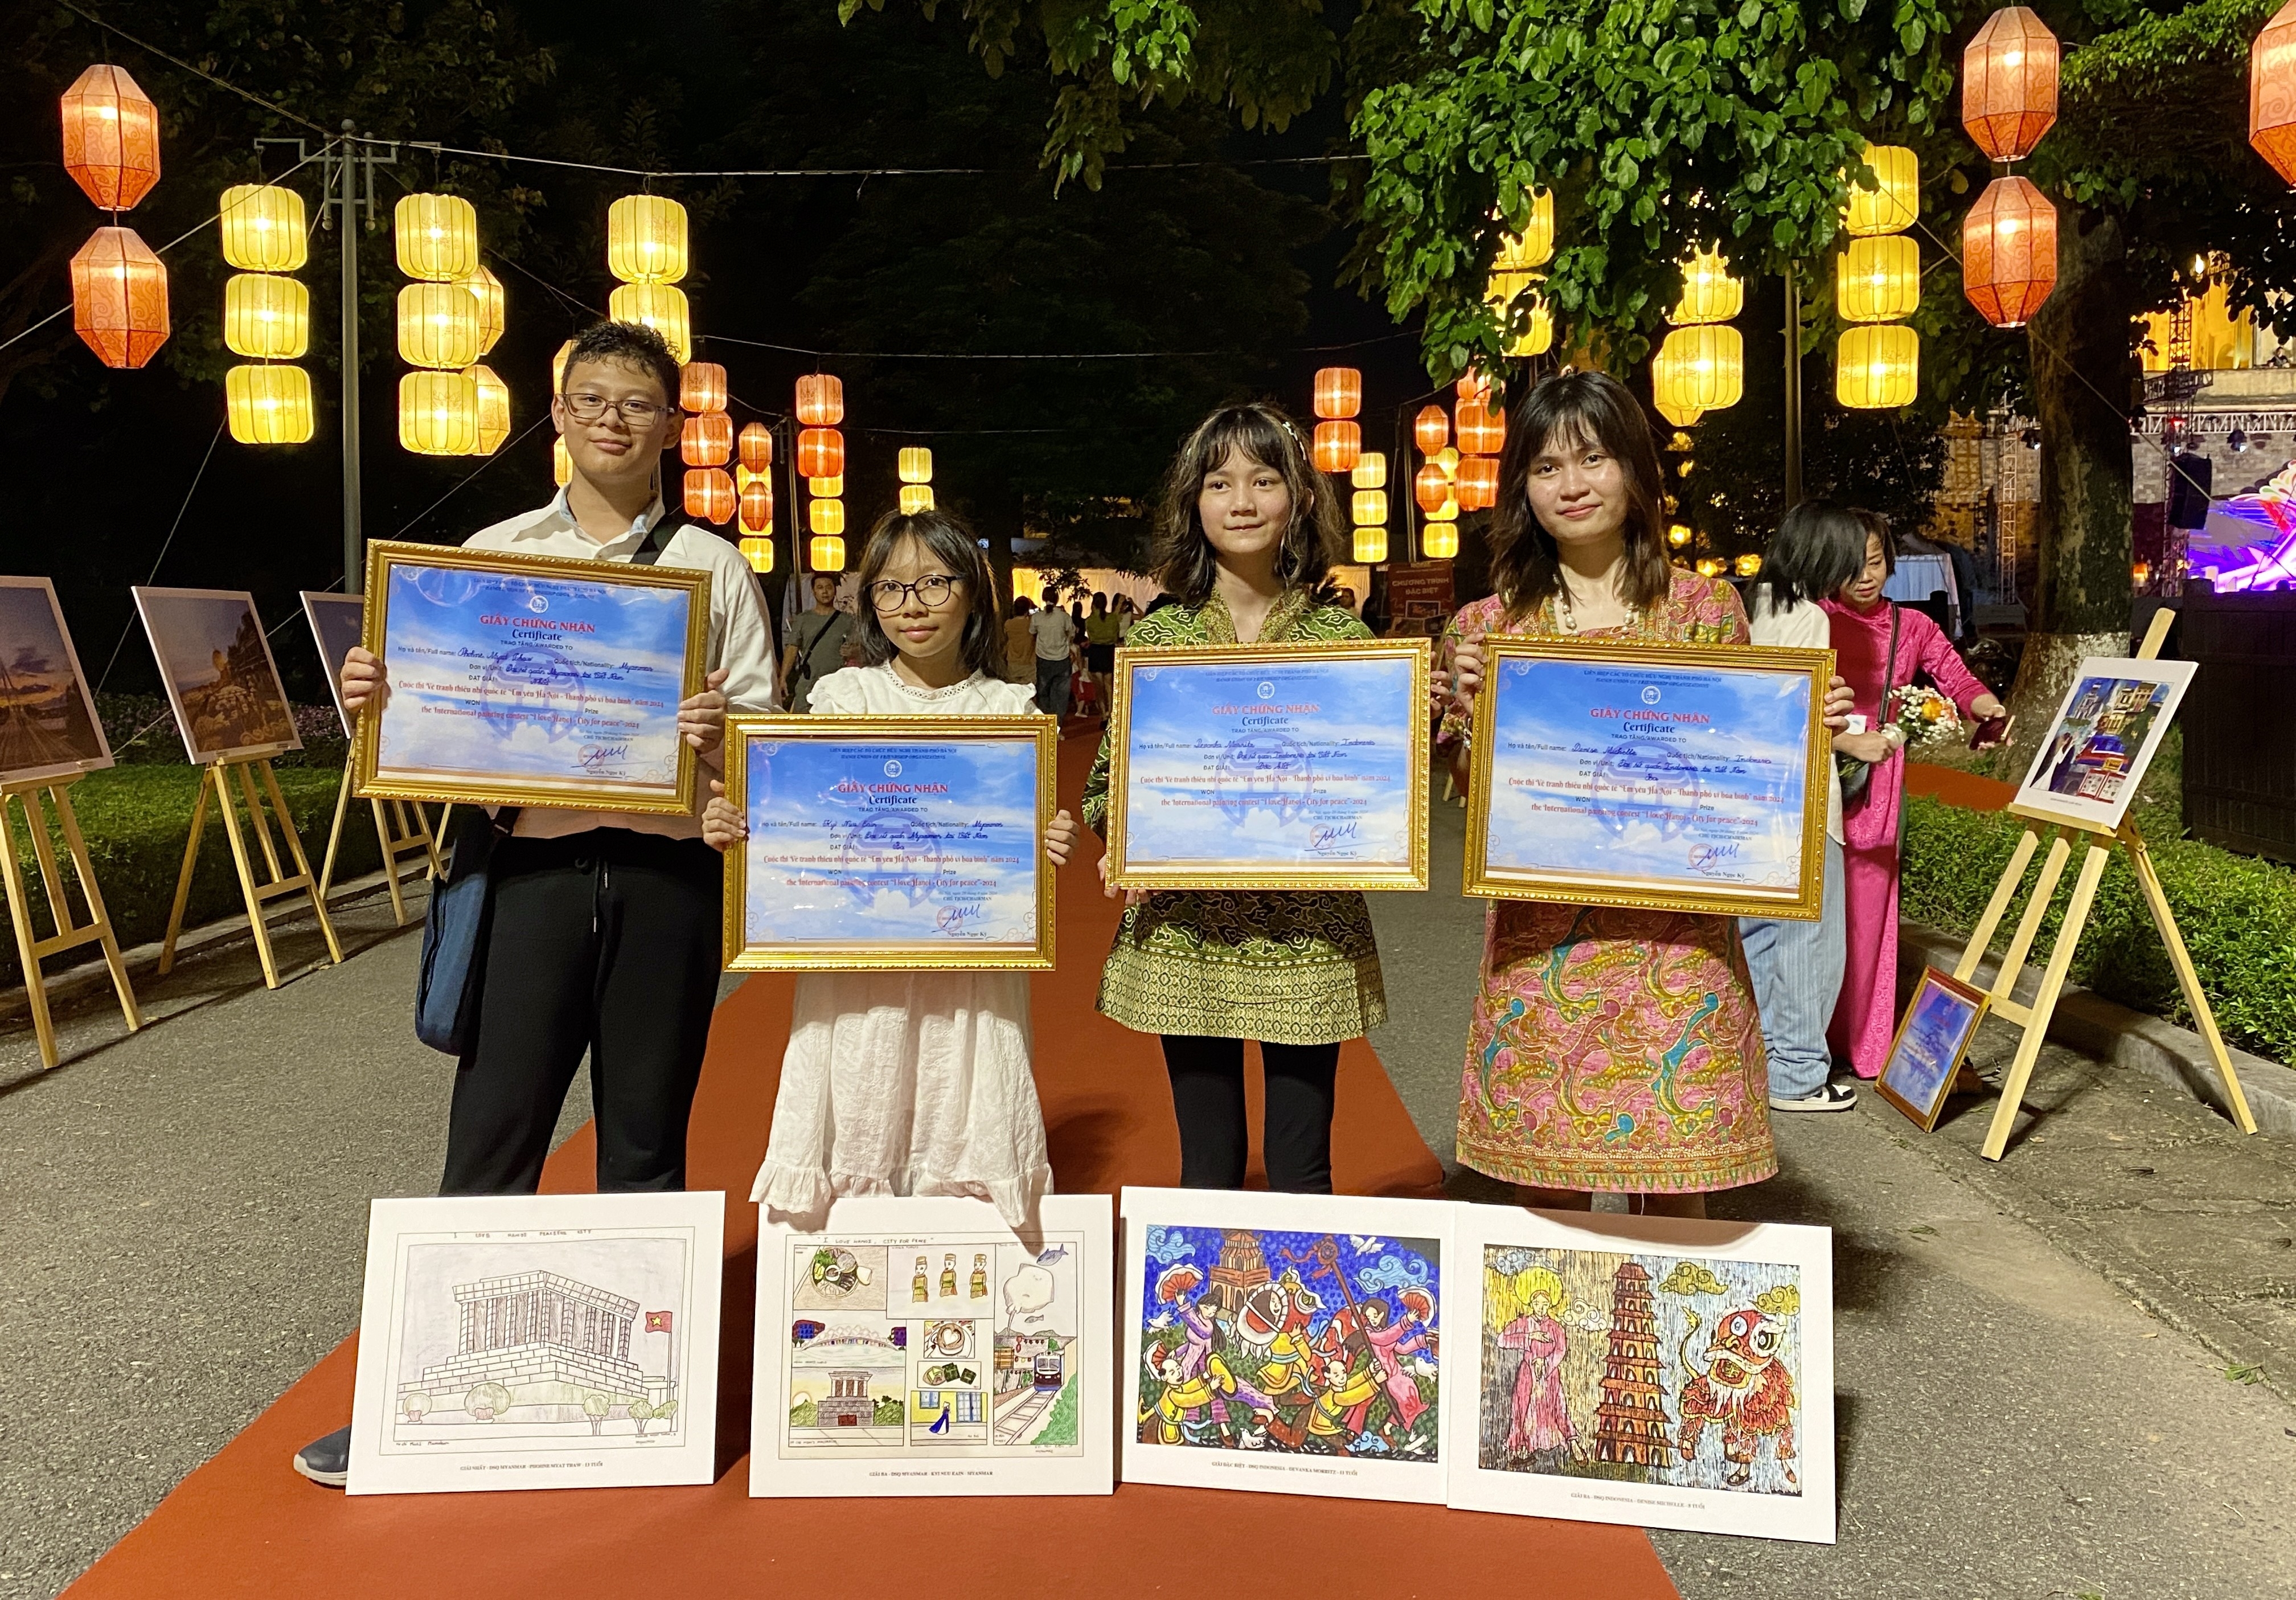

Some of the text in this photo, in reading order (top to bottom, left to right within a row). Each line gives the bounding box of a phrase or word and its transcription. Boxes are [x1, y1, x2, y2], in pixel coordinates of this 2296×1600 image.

[479, 612, 595, 634] GIẤY CHỨNG NHẬN
[512, 628, 563, 643] Certificate
[1242, 715, 1289, 726] Certificate
[1590, 705, 1709, 726] GIẤY CHỨNG NHẬN
[1623, 722, 1675, 735] Certificate
[838, 781, 947, 795] GIẤY CHỨNG NHẬN
[869, 795, 917, 805] Certificate
